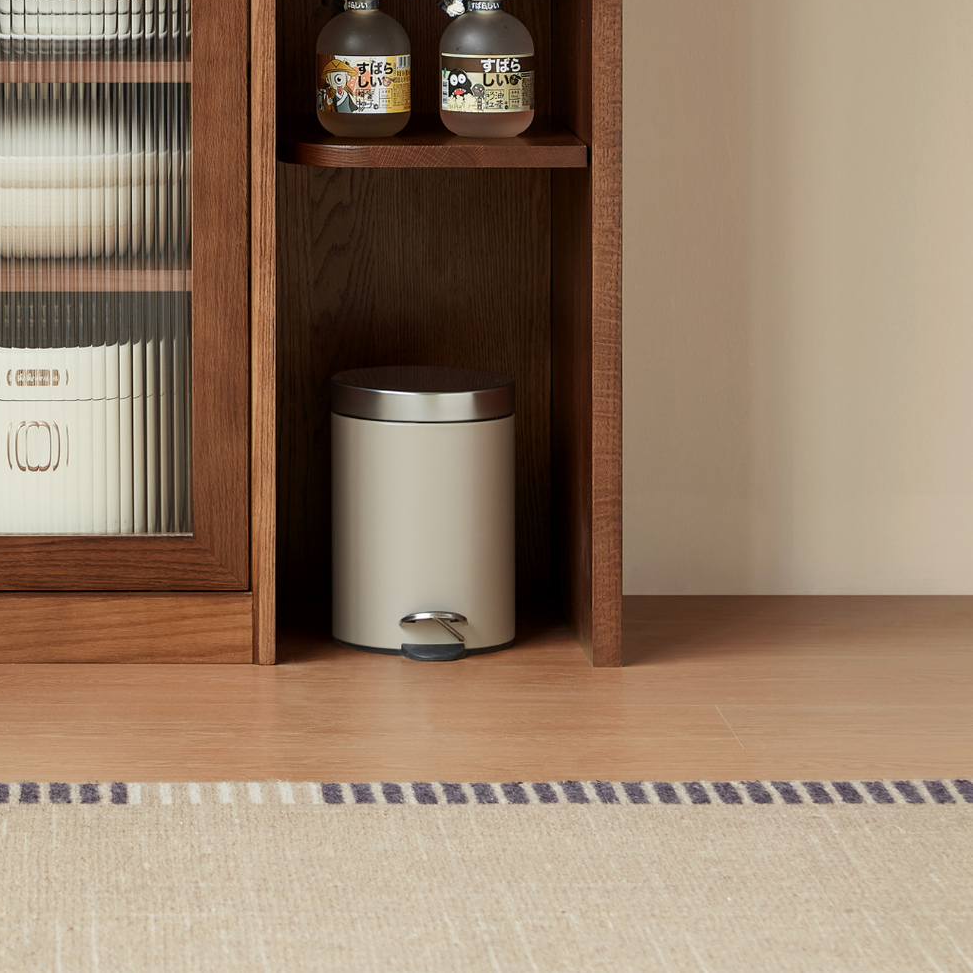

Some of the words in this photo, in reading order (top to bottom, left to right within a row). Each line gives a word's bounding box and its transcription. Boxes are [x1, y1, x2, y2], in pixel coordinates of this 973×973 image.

[356, 61, 394, 75] すばら
[480, 57, 521, 73] すばら
[358, 75, 383, 88] しい
[483, 73, 510, 87] しい
